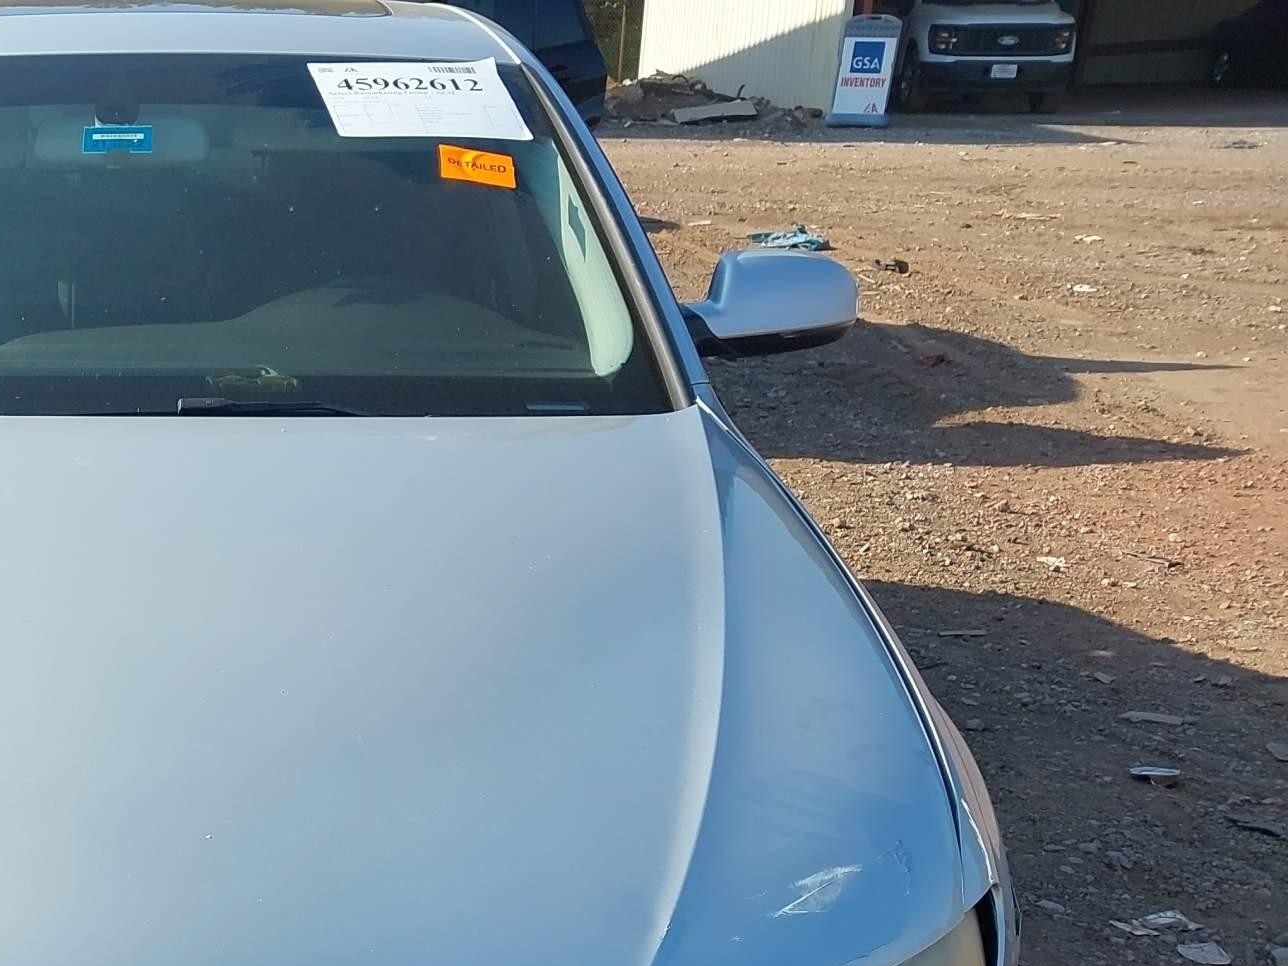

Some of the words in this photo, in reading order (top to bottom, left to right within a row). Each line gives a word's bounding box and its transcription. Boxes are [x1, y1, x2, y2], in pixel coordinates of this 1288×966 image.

[852, 56, 881, 70] GSA
[337, 77, 483, 92] 45962612
[840, 77, 887, 89] INVENTORY
[447, 157, 507, 174] DETAILED
